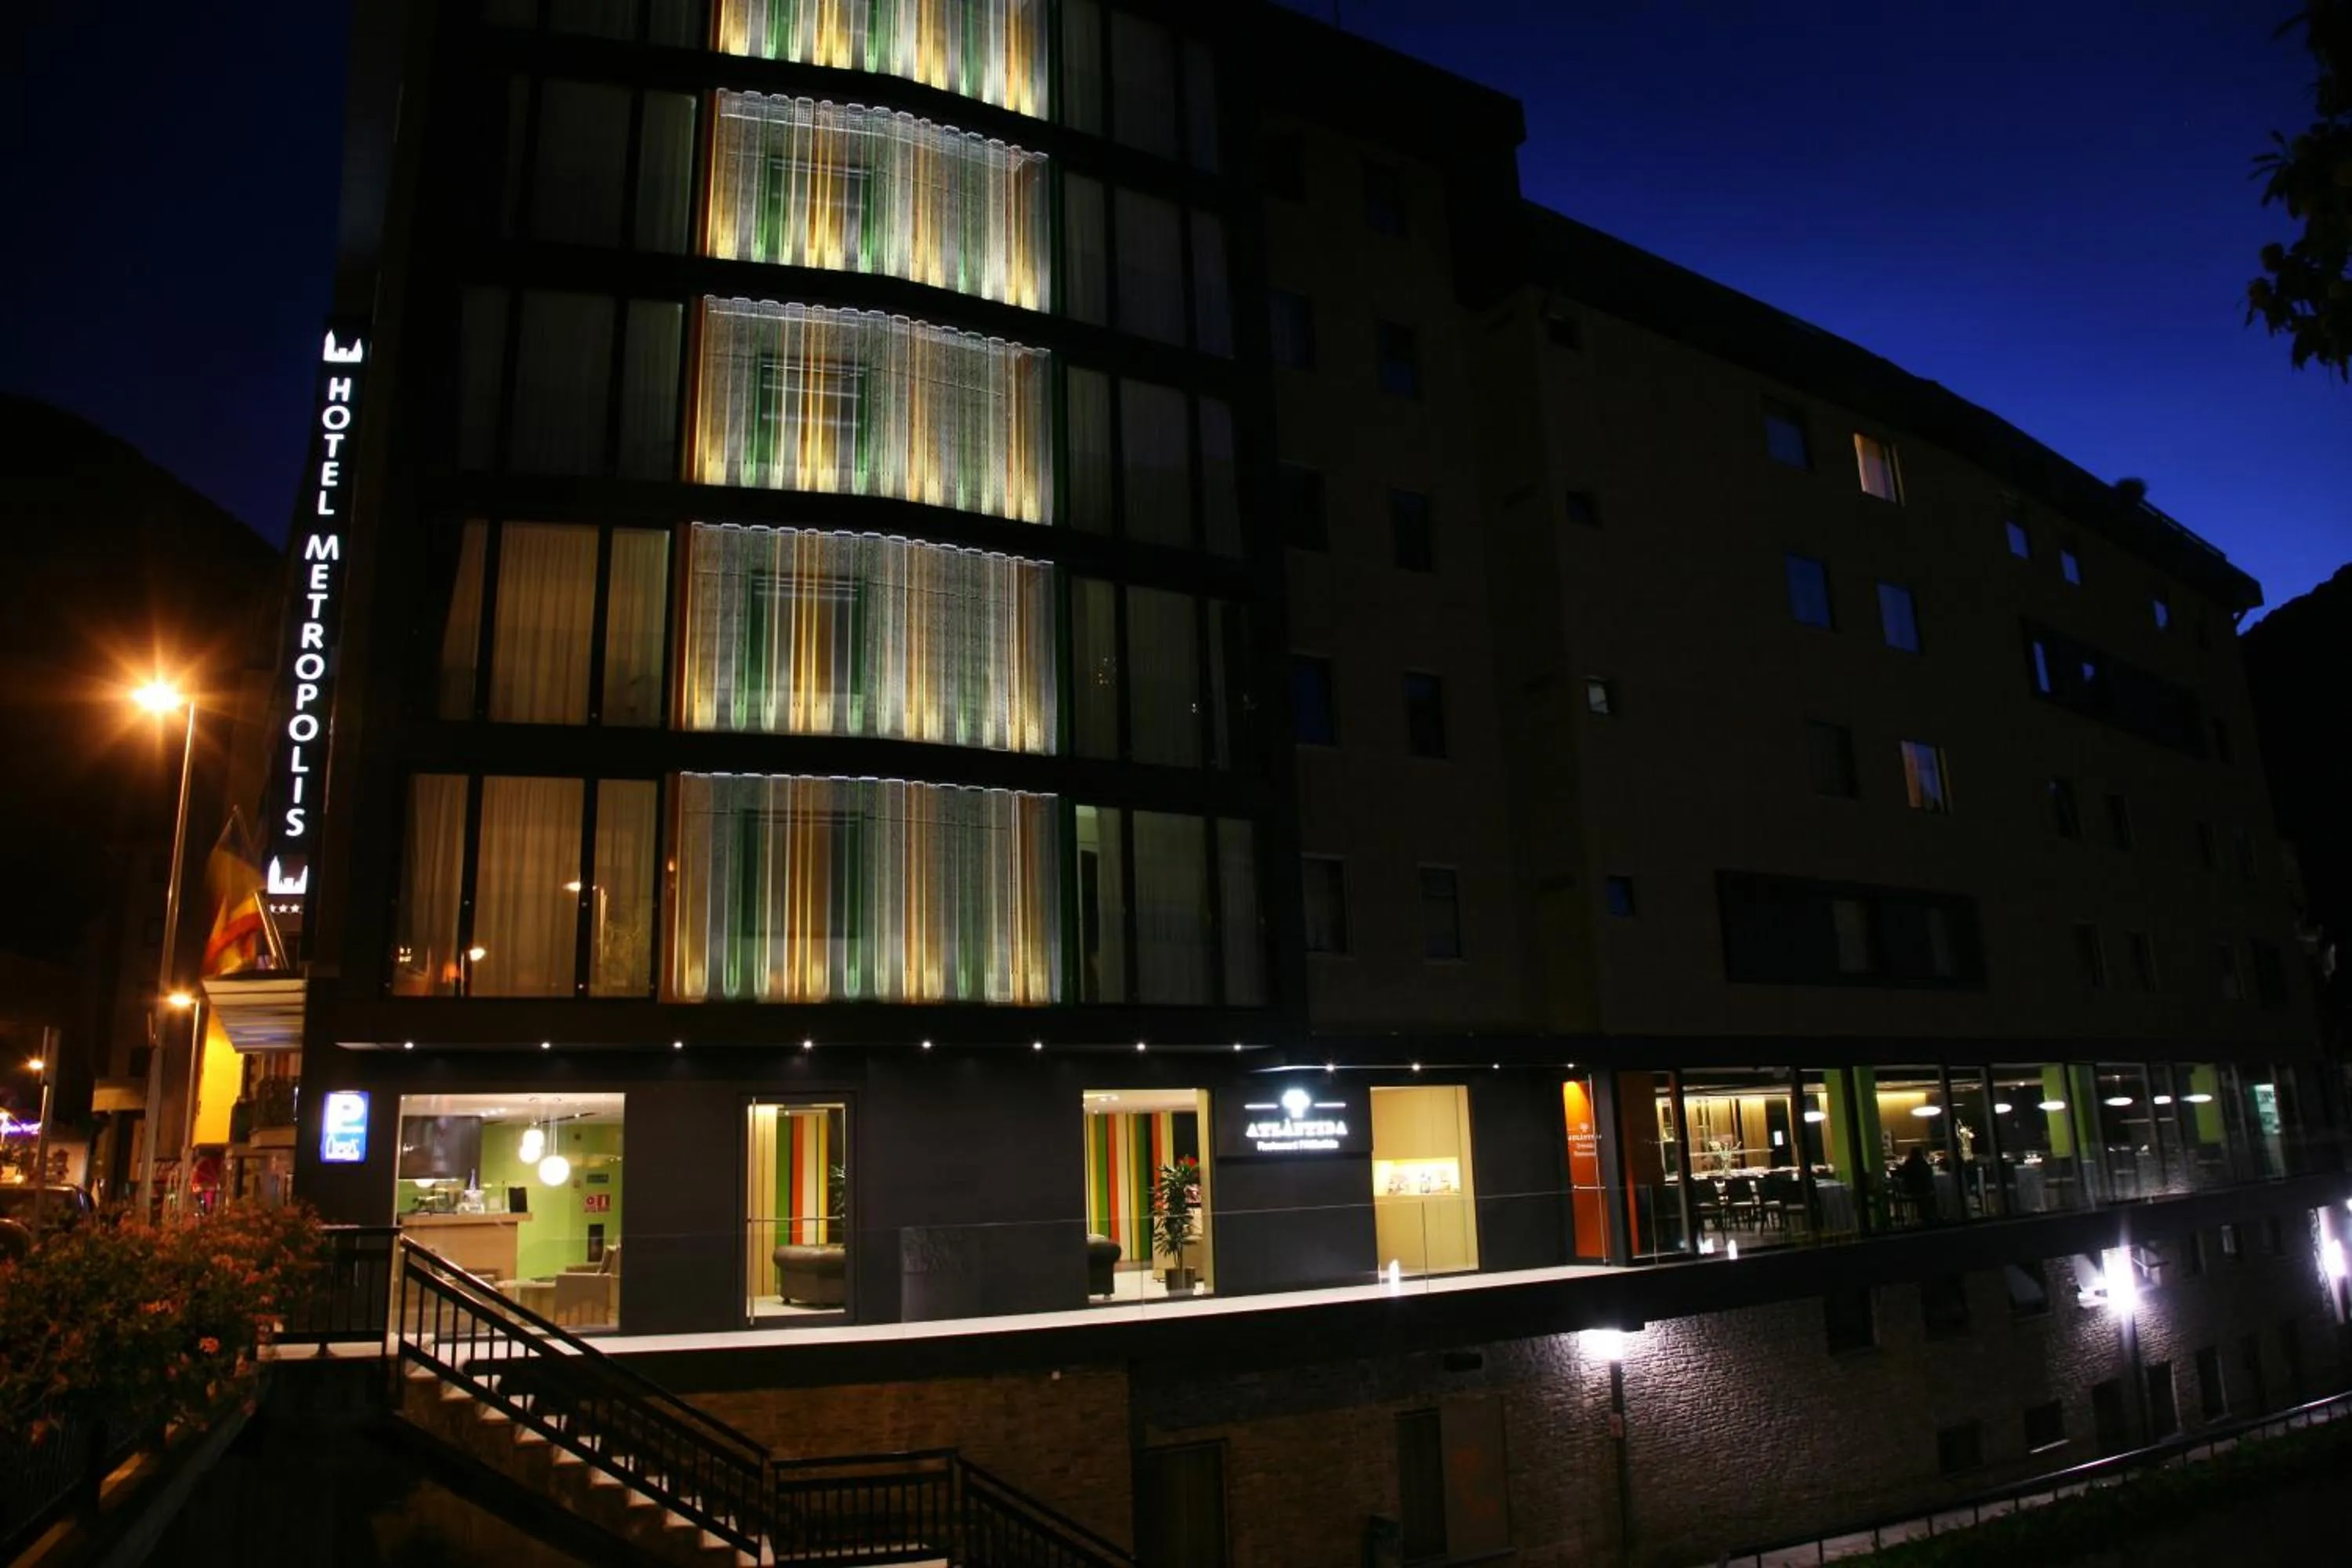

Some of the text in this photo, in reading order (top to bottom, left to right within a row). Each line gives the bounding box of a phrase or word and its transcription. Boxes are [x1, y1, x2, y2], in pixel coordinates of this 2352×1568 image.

[285, 377, 352, 837] HOTEL METROPOLIS
[328, 1094, 365, 1132] P
